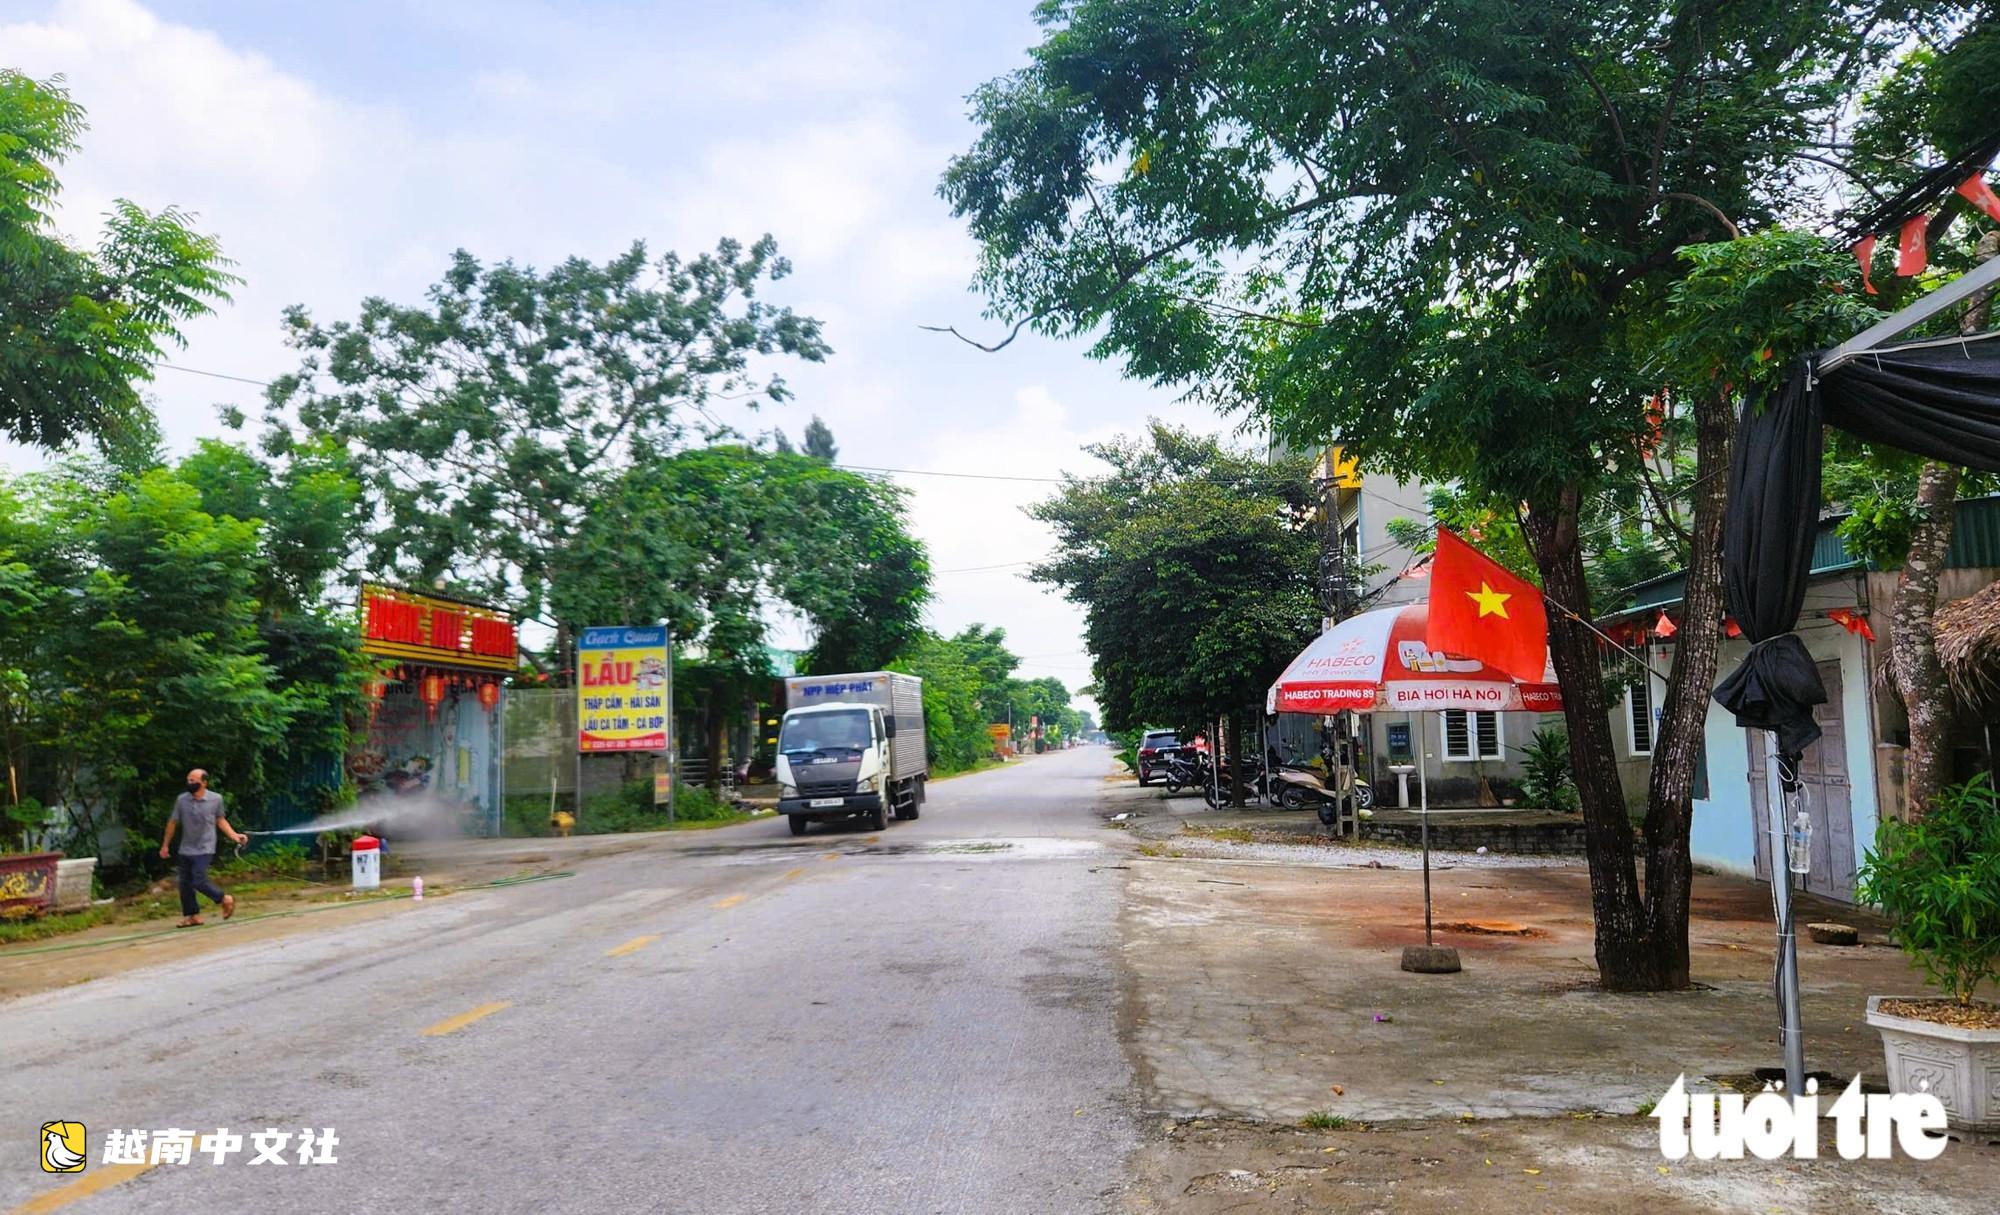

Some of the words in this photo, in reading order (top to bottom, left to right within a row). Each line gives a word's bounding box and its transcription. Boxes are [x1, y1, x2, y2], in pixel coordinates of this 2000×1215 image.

[1307, 655, 1375, 668] HABECO
[582, 652, 633, 686] LẨU
[803, 685, 822, 696] NPP
[1284, 690, 1321, 700] HABECO
[1321, 689, 1361, 699] TRADING
[1362, 689, 1374, 698] 89
[1397, 690, 1419, 701] BIA
[1424, 689, 1448, 700] HƠI
[1453, 686, 1472, 700] HÀ
[1476, 688, 1501, 701] NỘI
